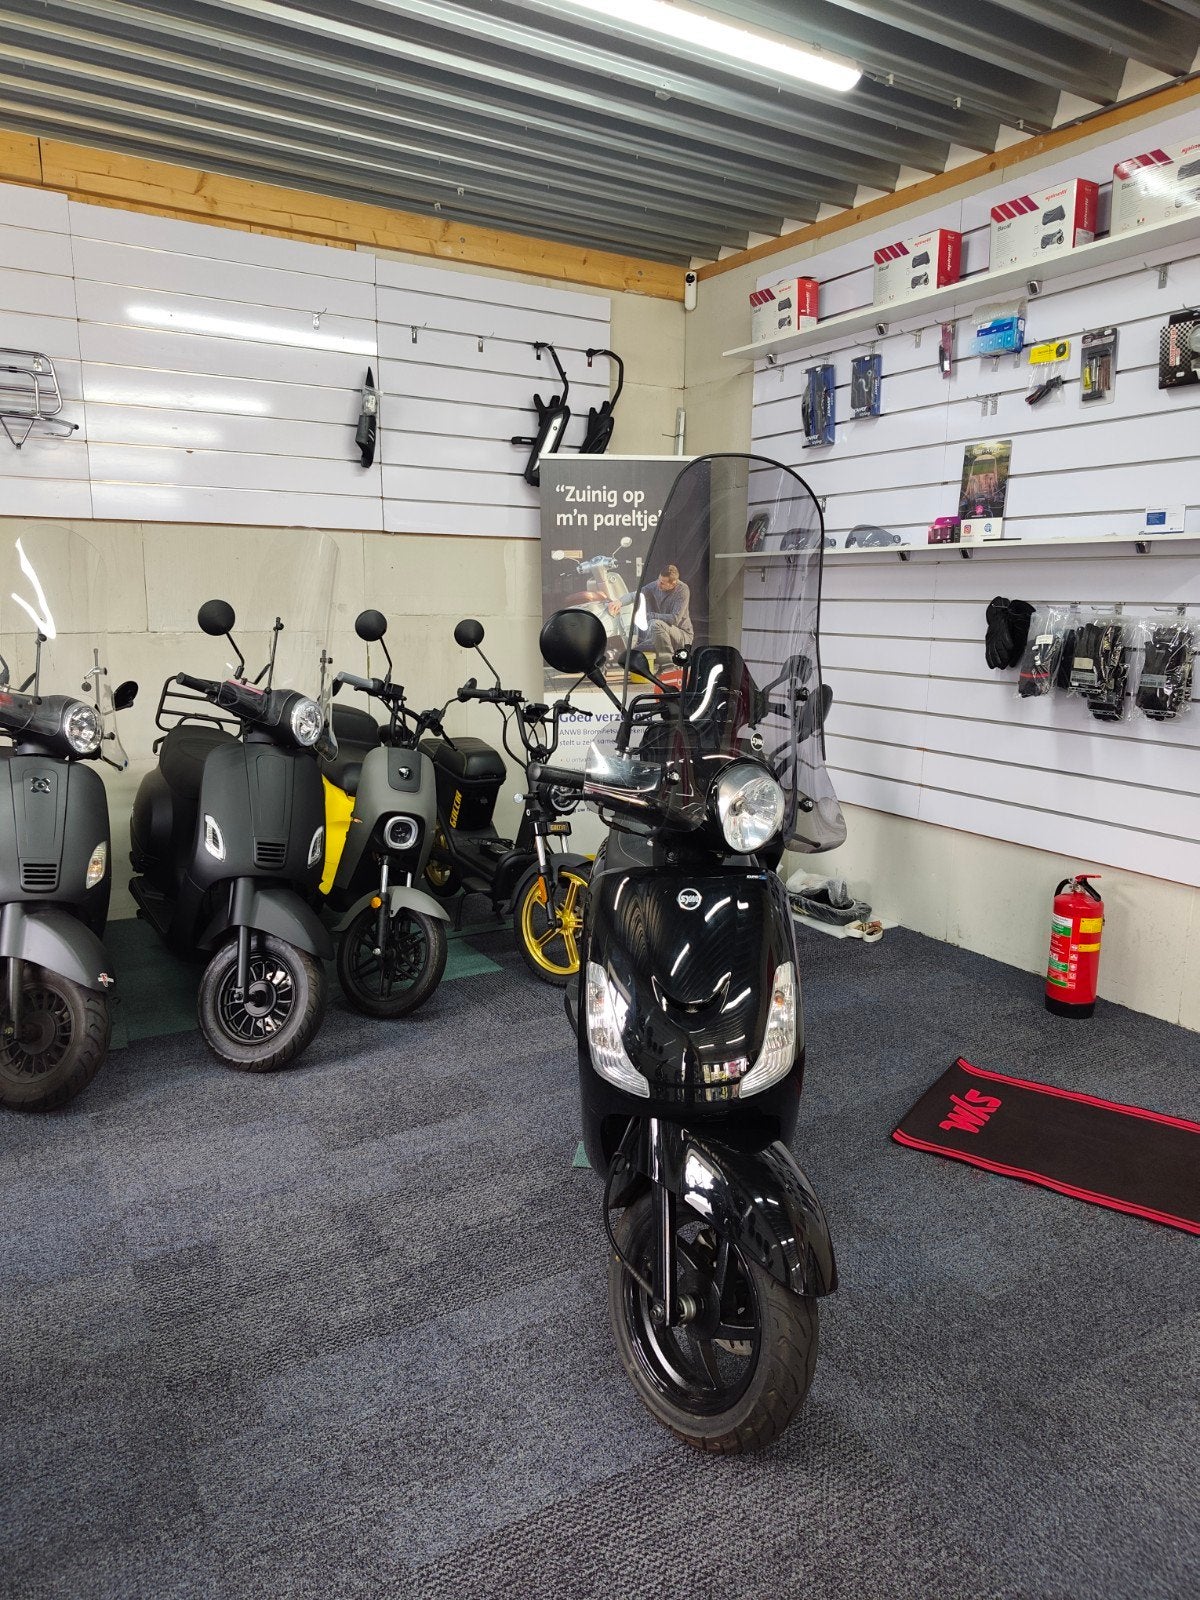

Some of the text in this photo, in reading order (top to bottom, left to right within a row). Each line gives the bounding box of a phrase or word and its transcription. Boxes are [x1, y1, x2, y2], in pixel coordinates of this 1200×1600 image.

[556, 484, 645, 507] “Zuinig op
[556, 509, 588, 526] m’n
[938, 1088, 1002, 1134] SYM
